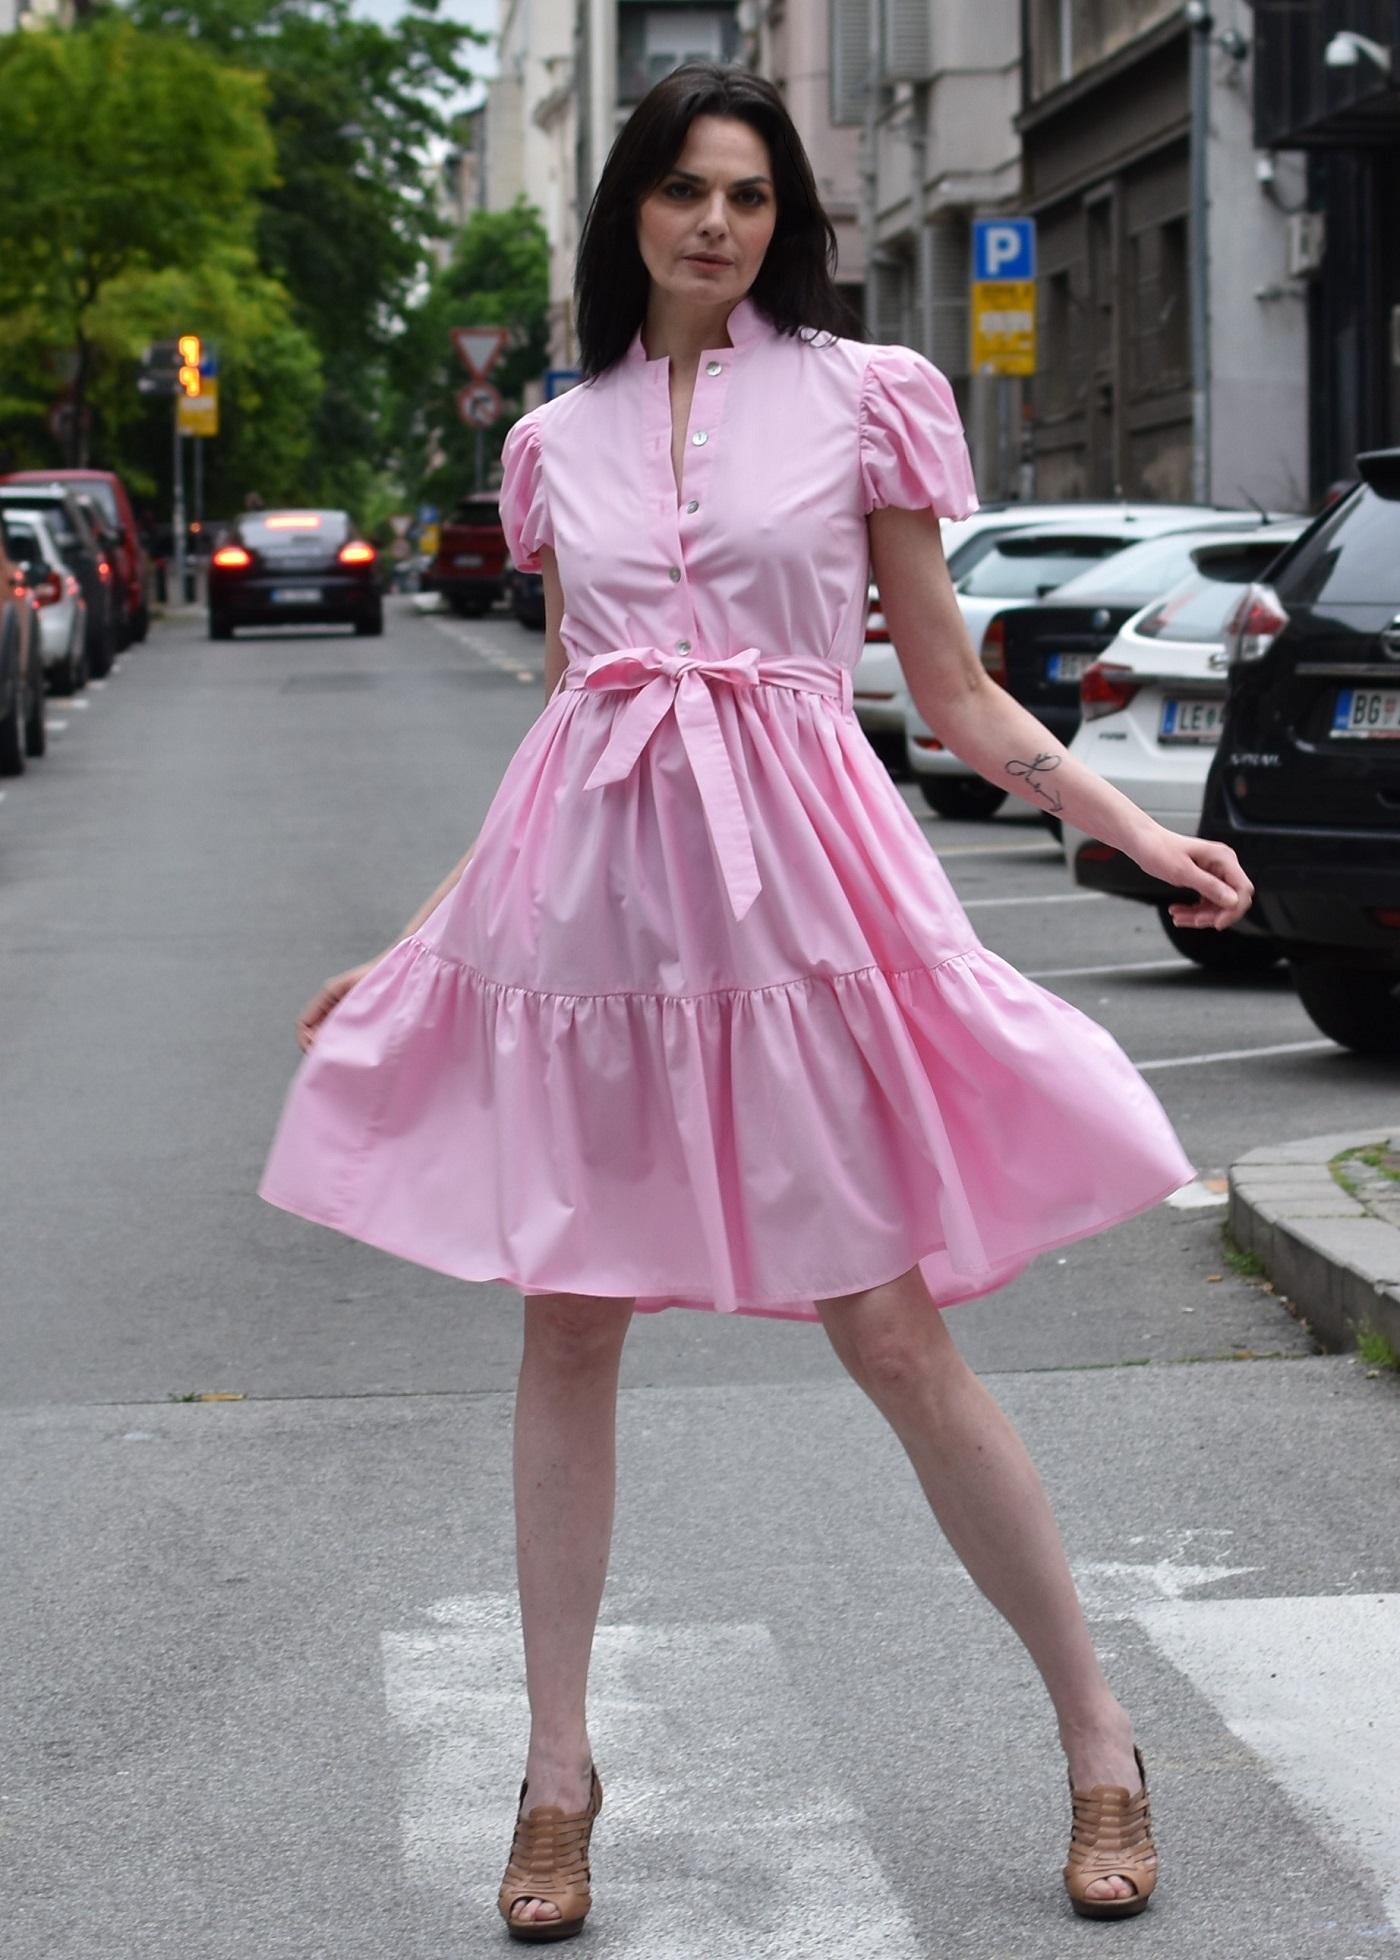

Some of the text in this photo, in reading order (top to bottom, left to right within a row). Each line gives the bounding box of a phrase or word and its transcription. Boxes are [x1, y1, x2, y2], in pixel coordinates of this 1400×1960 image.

[986, 227, 1021, 275] P
[1179, 704, 1204, 731] LE
[1353, 694, 1381, 725] BG
